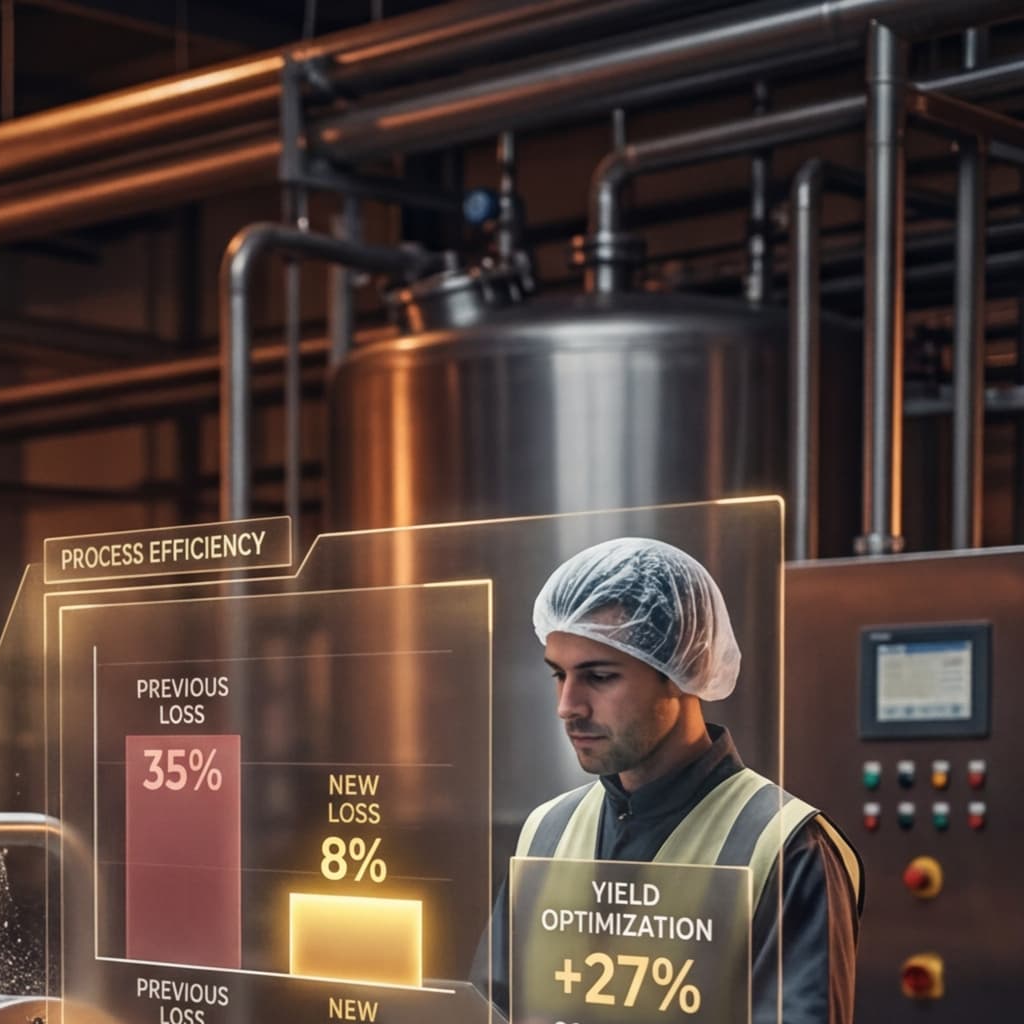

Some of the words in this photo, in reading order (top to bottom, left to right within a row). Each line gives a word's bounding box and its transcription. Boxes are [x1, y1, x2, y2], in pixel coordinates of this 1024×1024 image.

[61, 542, 144, 570] PROCESS
[150, 531, 266, 563] EFFICIENCY
[137, 676, 229, 699] PREVIOUS
[159, 705, 205, 725] LOSS
[143, 749, 222, 792] 35%
[329, 774, 380, 796] NEW
[328, 803, 381, 824] LOSS
[320, 837, 387, 883] 8%
[592, 881, 660, 906] YIELD
[541, 909, 713, 941] OPTIMIZATION
[137, 978, 229, 1006] PREVIOUS
[554, 952, 702, 1014] +27%
[329, 998, 379, 1023] NEW
